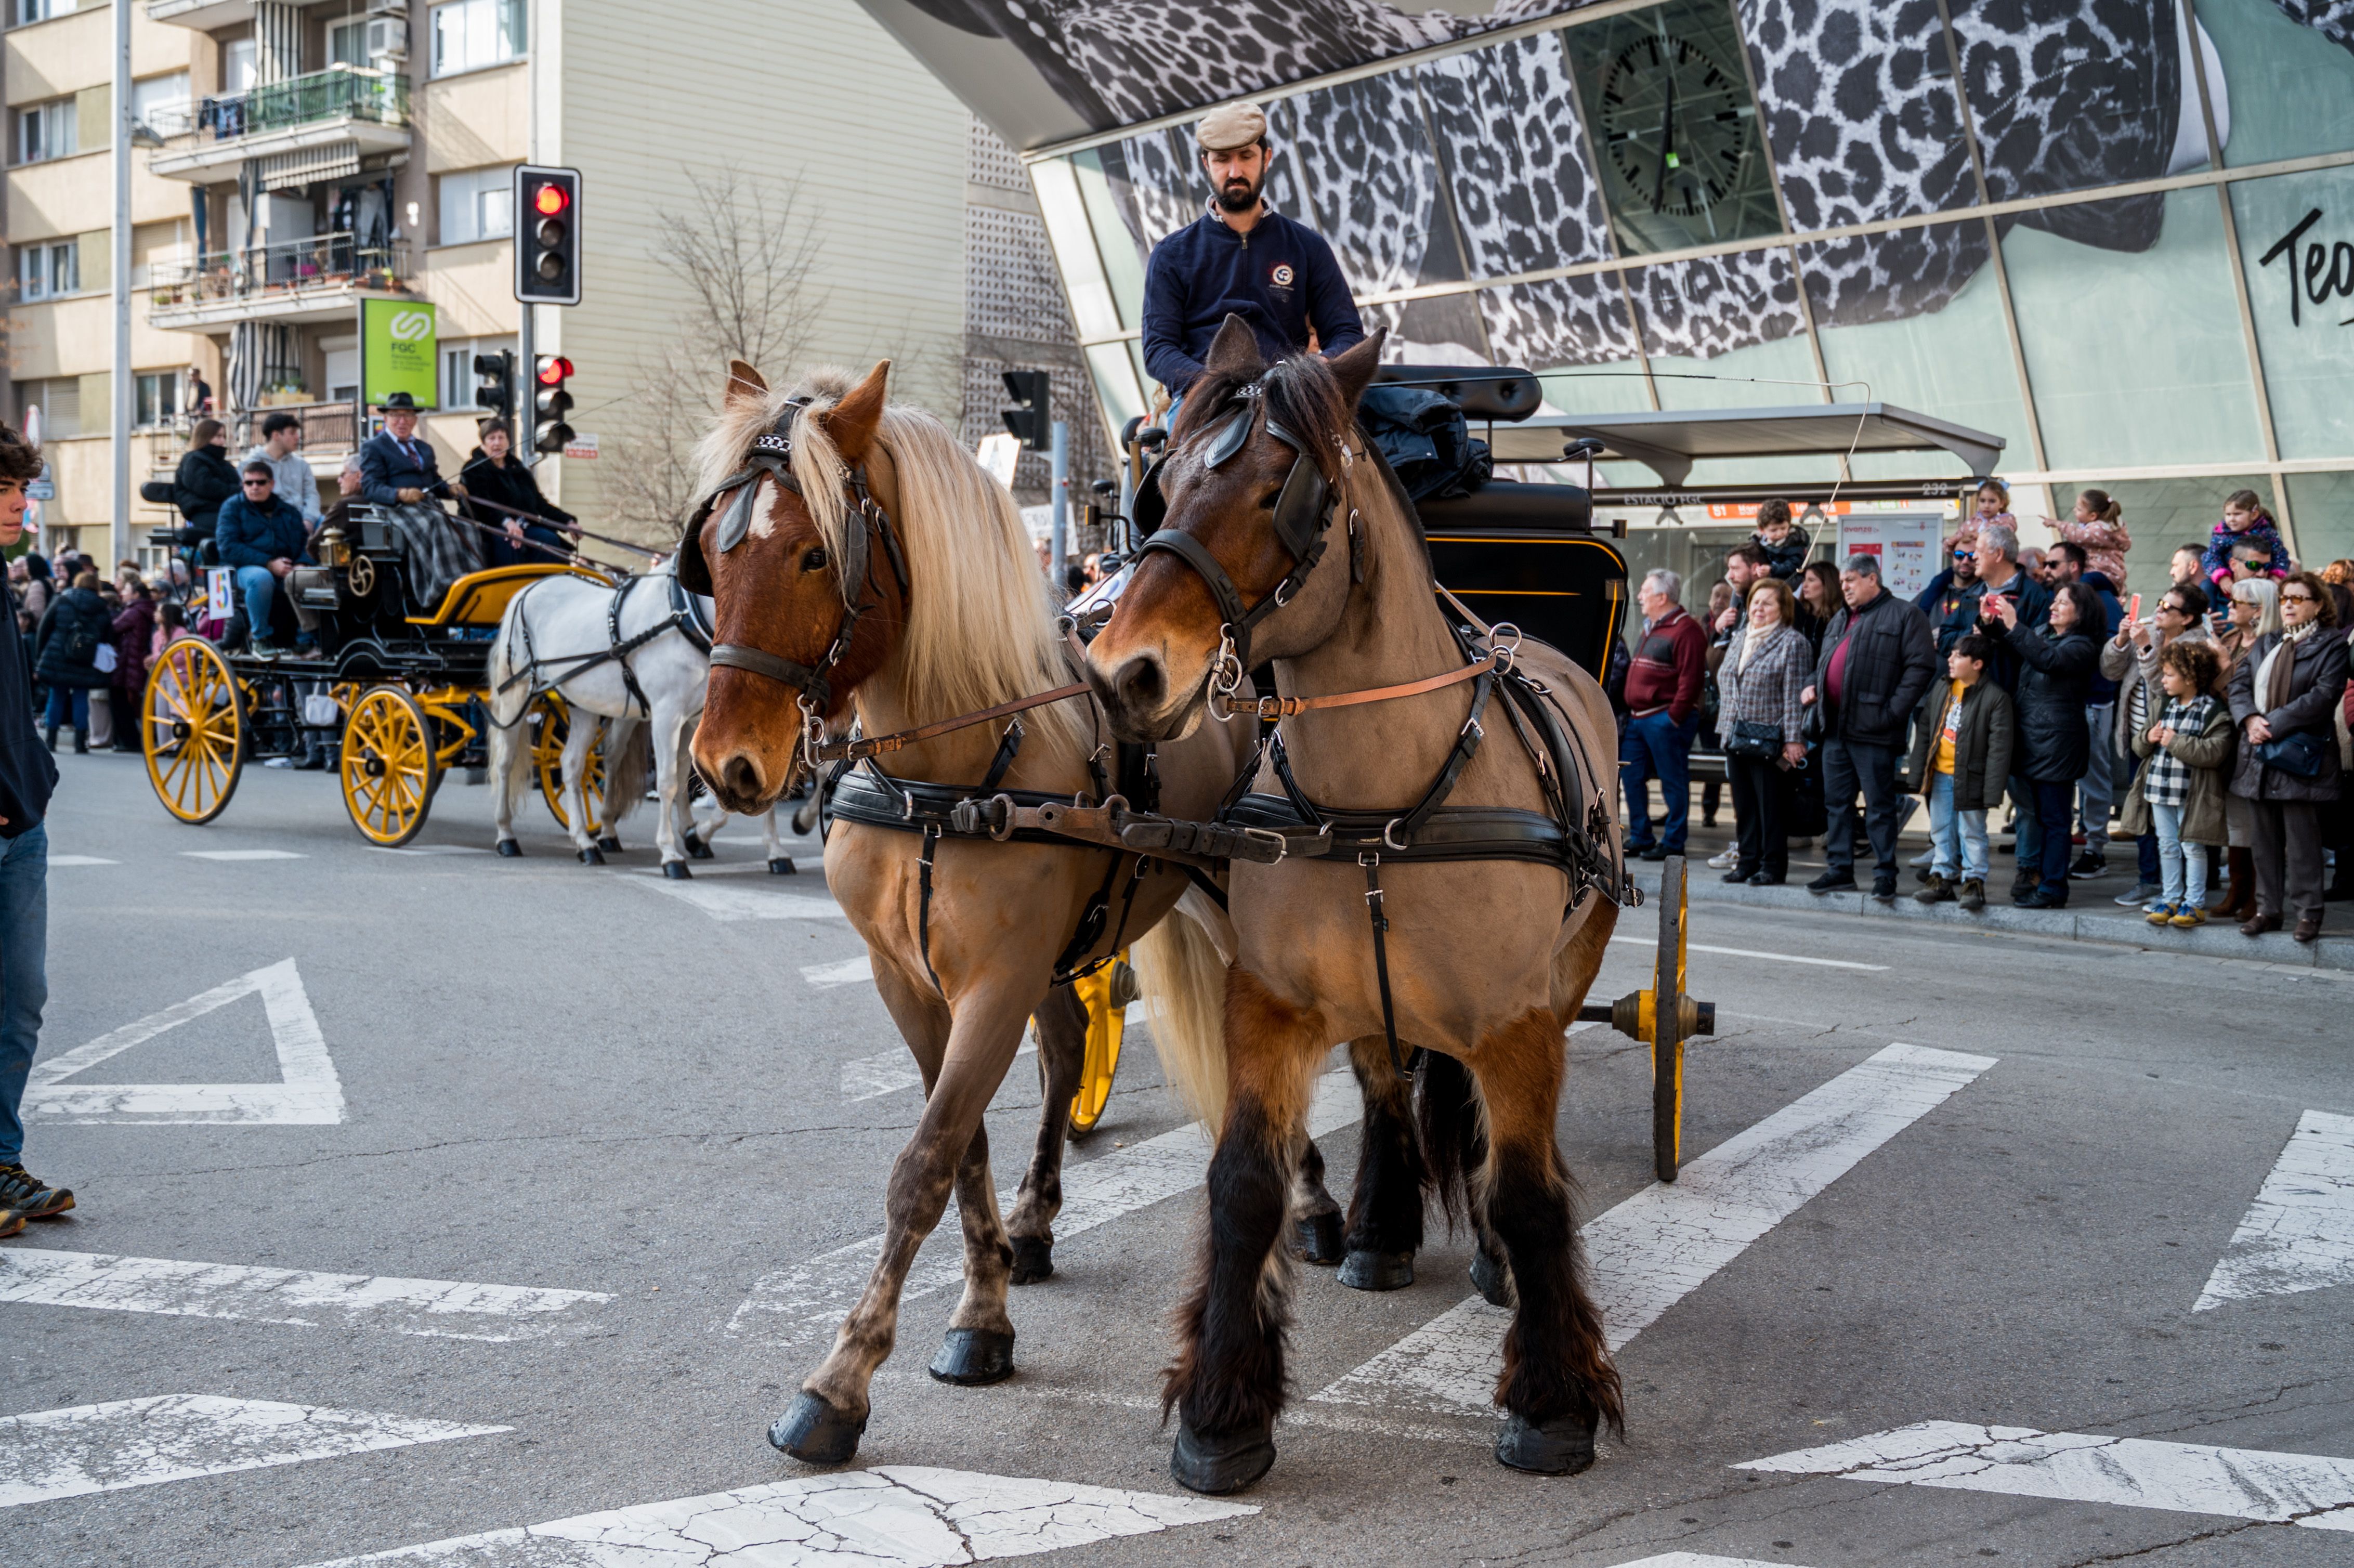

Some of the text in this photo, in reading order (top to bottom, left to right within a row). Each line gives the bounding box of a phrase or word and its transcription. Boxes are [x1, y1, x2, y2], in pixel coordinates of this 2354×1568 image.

[391, 342, 416, 354] FGC
[1922, 483, 1948, 496] 232
[1624, 490, 1705, 505] ESTACIÓ FGC
[216, 573, 229, 610] 5
